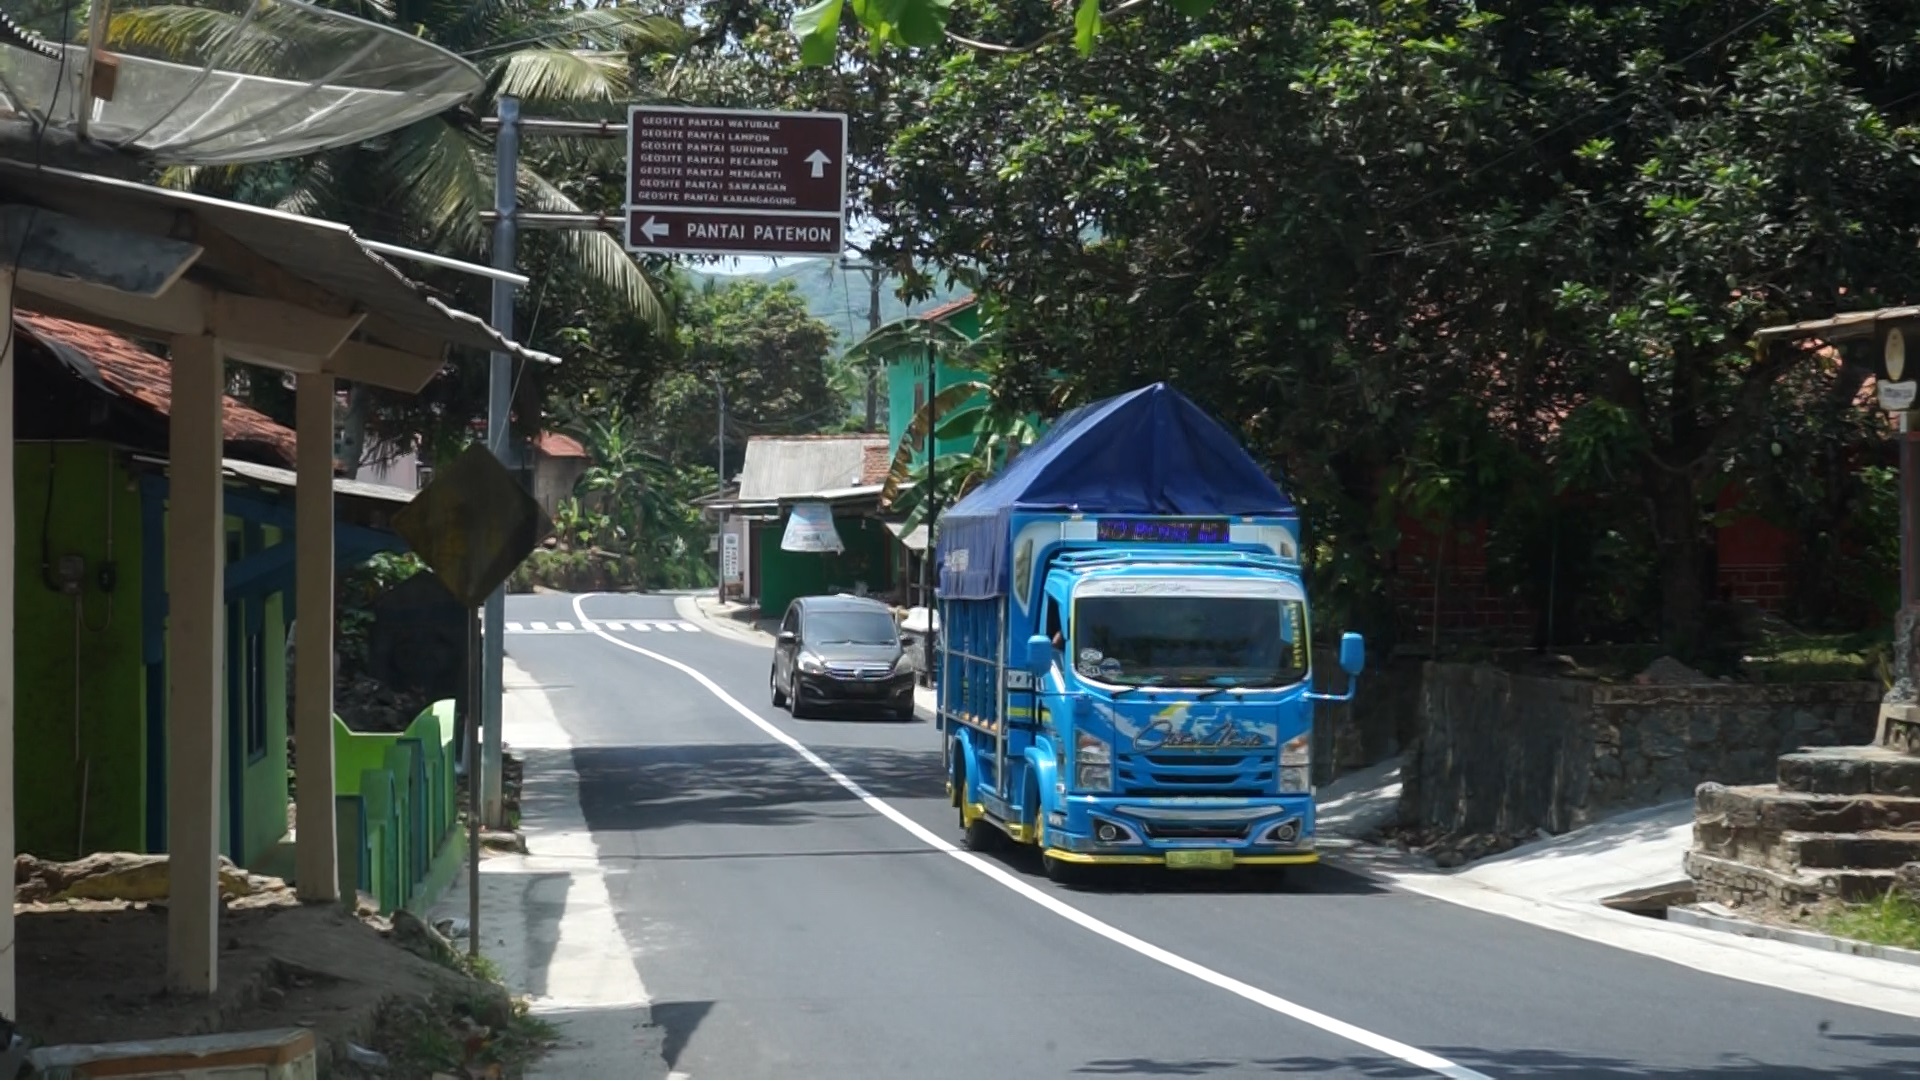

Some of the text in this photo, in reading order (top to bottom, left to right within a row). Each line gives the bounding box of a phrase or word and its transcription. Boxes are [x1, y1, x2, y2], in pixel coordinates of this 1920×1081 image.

[642, 116, 685, 127] GEOSITE
[688, 118, 725, 127] PANTAI
[641, 128, 770, 142] GEOSITE PANTAI LAMPON
[641, 140, 789, 156] GEOSITE PANTAI SURUMANIS
[640, 153, 683, 163] GEOSITE
[686, 155, 725, 165] PANTAI
[640, 165, 782, 179] GEOSITE PANTAI MENGANTI
[639, 178, 787, 192] GEOSITE PANTAI SAWANGAN
[638, 190, 797, 206] GEOSITE PANTAI KARANGAGUNG
[686, 222, 832, 243] PANTAI PATEMON
